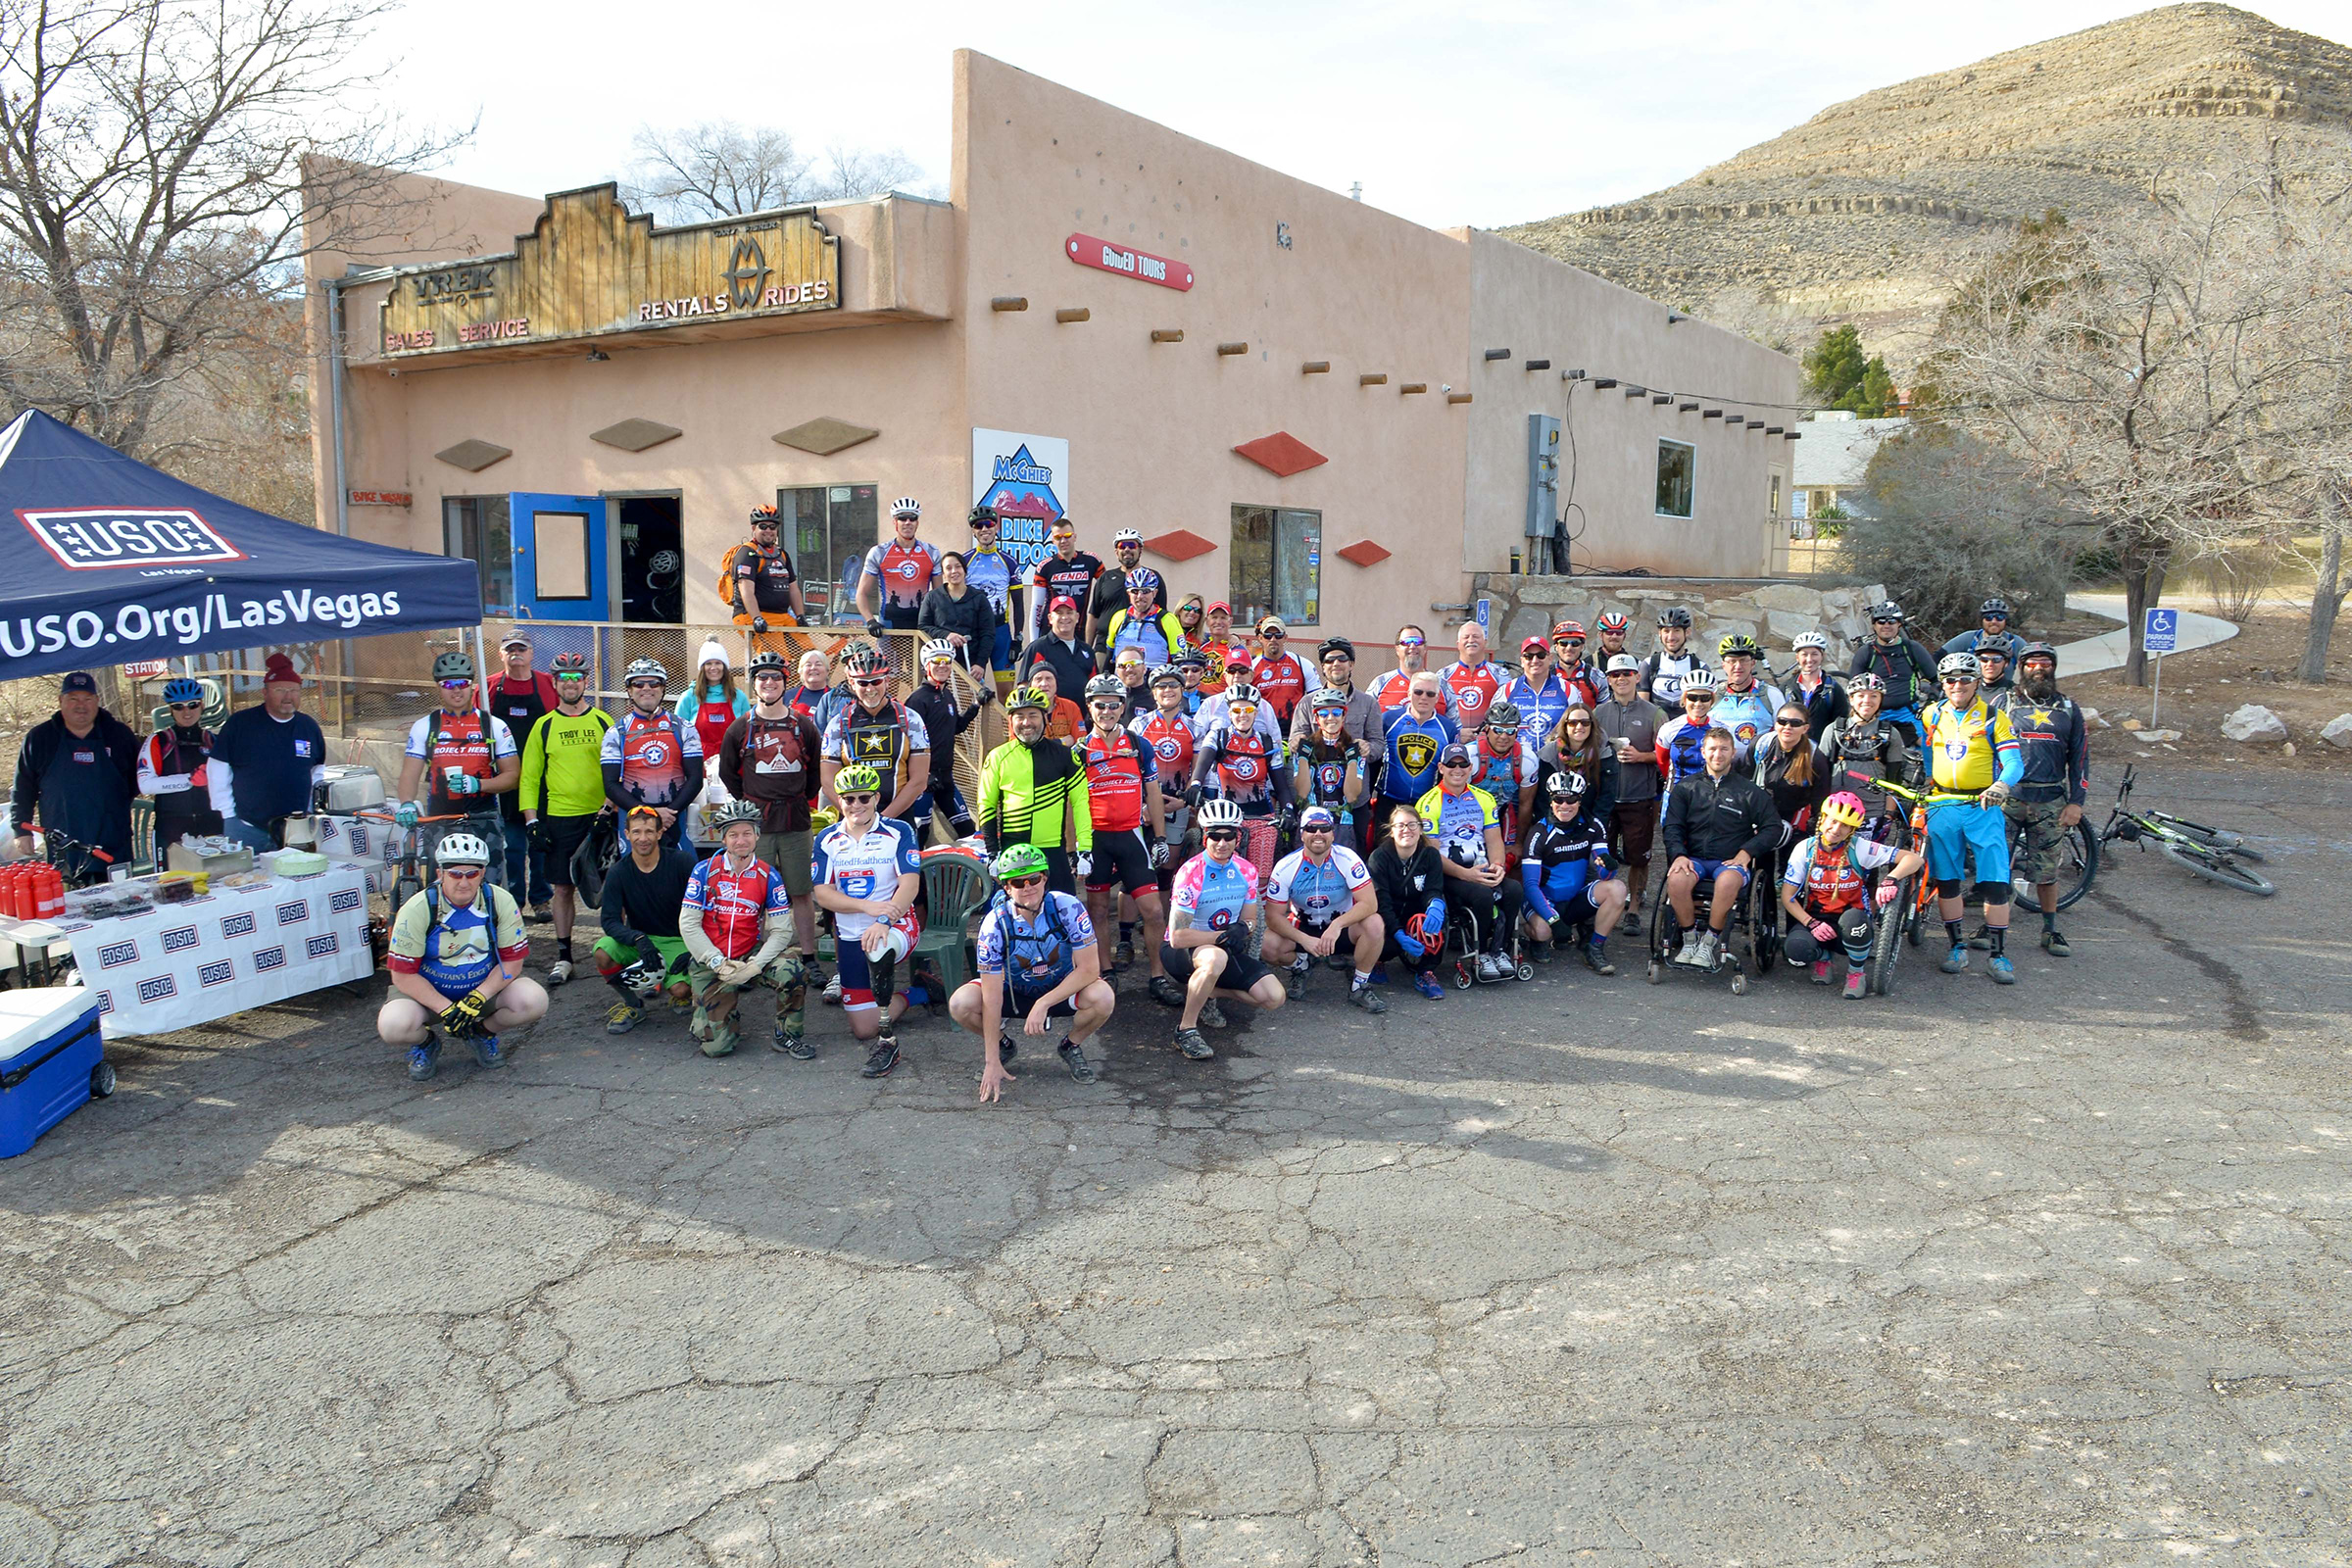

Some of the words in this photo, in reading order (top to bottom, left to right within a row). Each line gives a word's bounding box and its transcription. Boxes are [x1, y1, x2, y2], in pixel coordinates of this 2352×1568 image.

[1138, 255, 1166, 280] TOURS
[414, 267, 495, 297] TREK
[764, 279, 829, 307] RIDES
[639, 294, 729, 322] RENTALS
[460, 318, 528, 342] SERVICE
[385, 329, 435, 351] SALES
[353, 491, 376, 502] BIKE
[1001, 517, 1044, 541] BIKE
[71, 519, 193, 556] USO
[996, 541, 1058, 564] UTPOS
[1051, 571, 1089, 582] KENDA
[0, 589, 402, 659] USO.Org/LasVegas
[124, 660, 169, 675] STATION
[1257, 678, 1282, 688] PROJECT
[559, 730, 579, 739] TROY
[1402, 736, 1435, 747] POLICE
[1095, 778, 1123, 788] PROJECT
[1553, 840, 1590, 854] SHIMANO
[1354, 866, 1364, 877] 2
[687, 884, 698, 895] 2
[847, 877, 867, 893] 2
[337, 892, 356, 908] USO
[777, 890, 787, 902] 2
[283, 905, 303, 921] USO
[714, 904, 743, 913] PROJECT
[228, 917, 249, 935] USO
[1081, 918, 1091, 930] 2
[171, 930, 194, 948] USO
[314, 938, 335, 954] USO
[109, 945, 131, 963] USO
[262, 951, 281, 966] USO
[979, 946, 988, 958] 2
[207, 964, 226, 983] USO
[146, 979, 169, 999] USO
